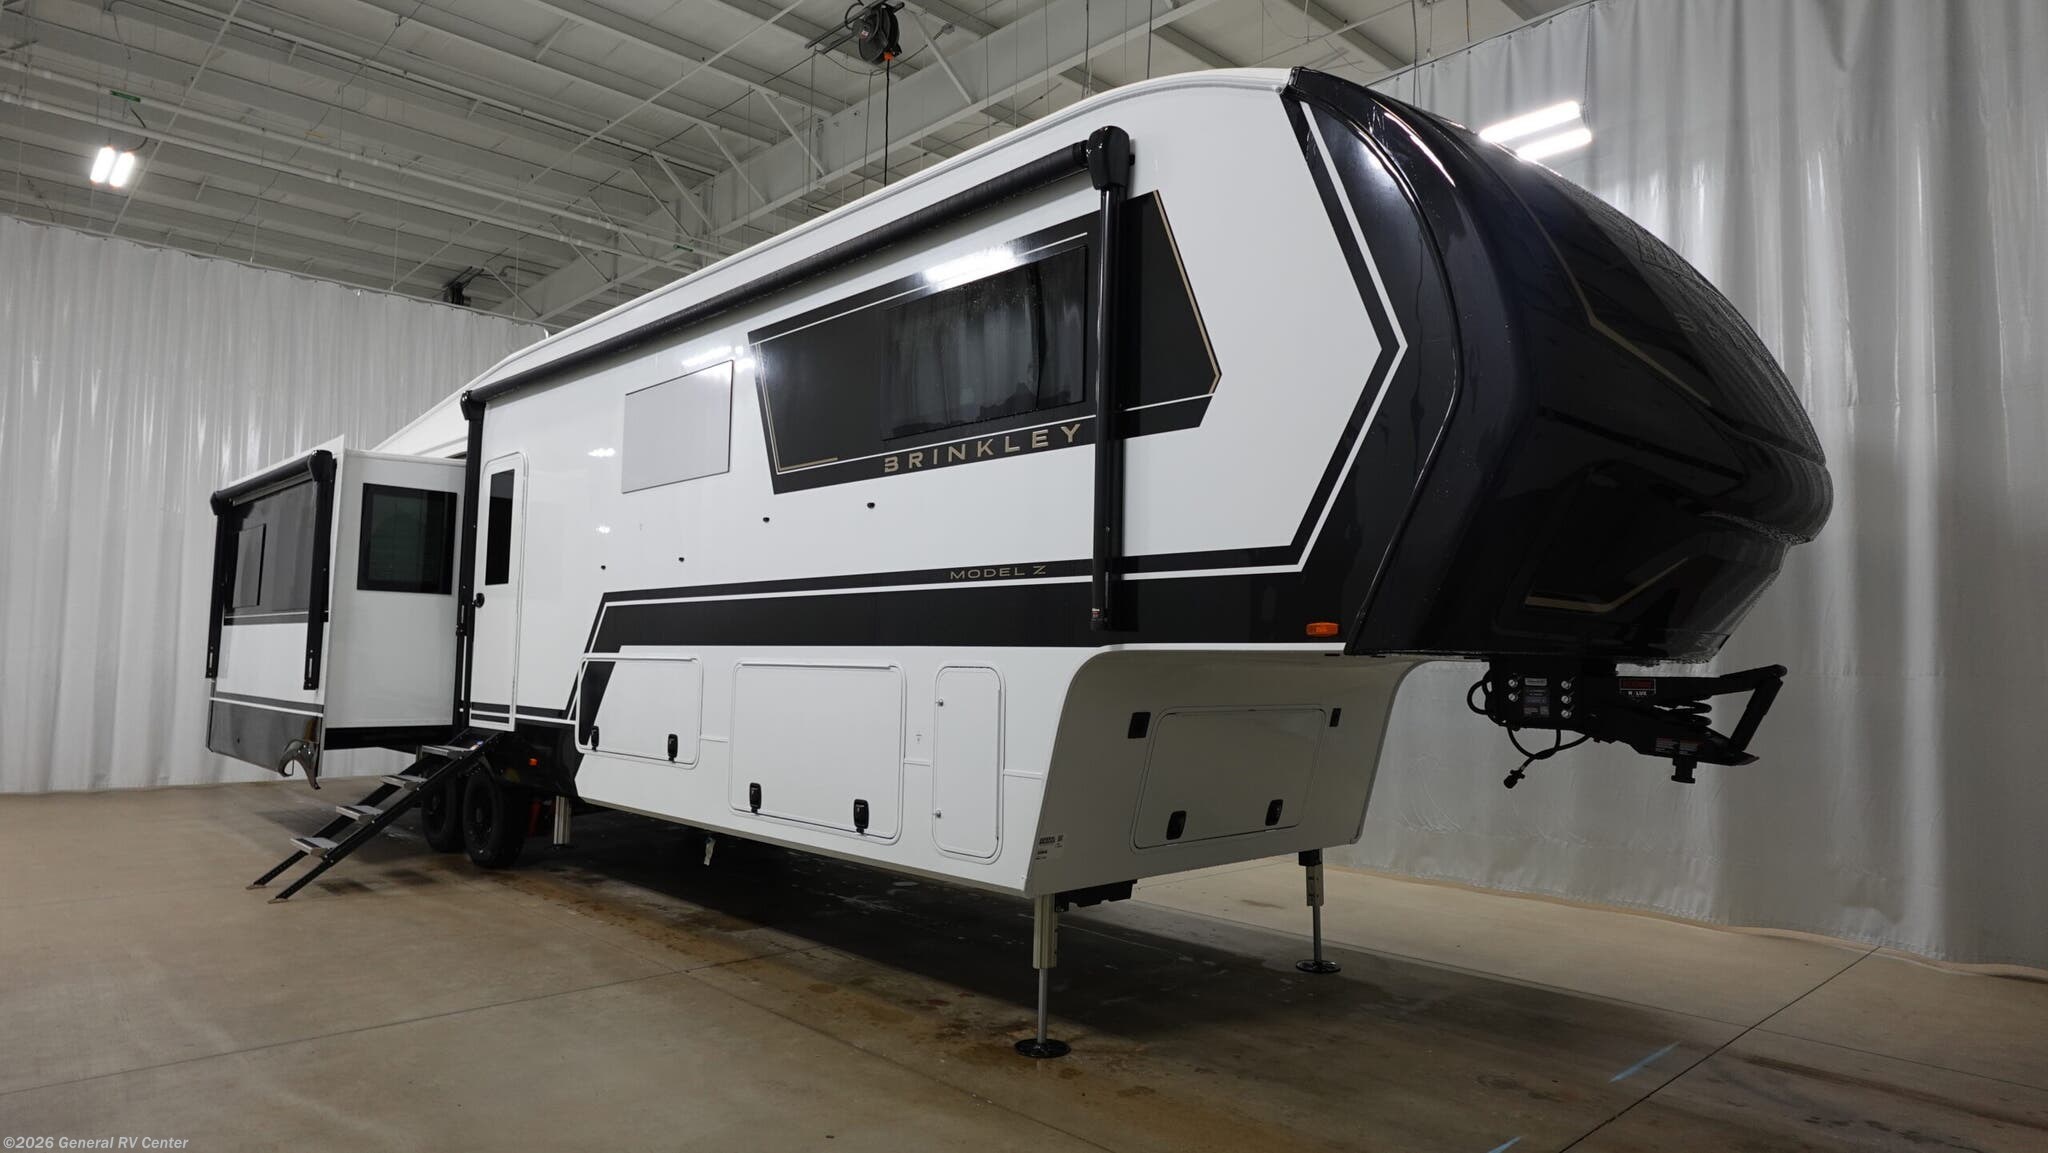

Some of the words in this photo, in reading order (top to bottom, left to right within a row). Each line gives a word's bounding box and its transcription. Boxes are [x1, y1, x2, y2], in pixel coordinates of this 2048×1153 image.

[884, 424, 1081, 473] BRINKLEY
[950, 567, 1025, 580] MODEL
[1033, 565, 1047, 575] Z
